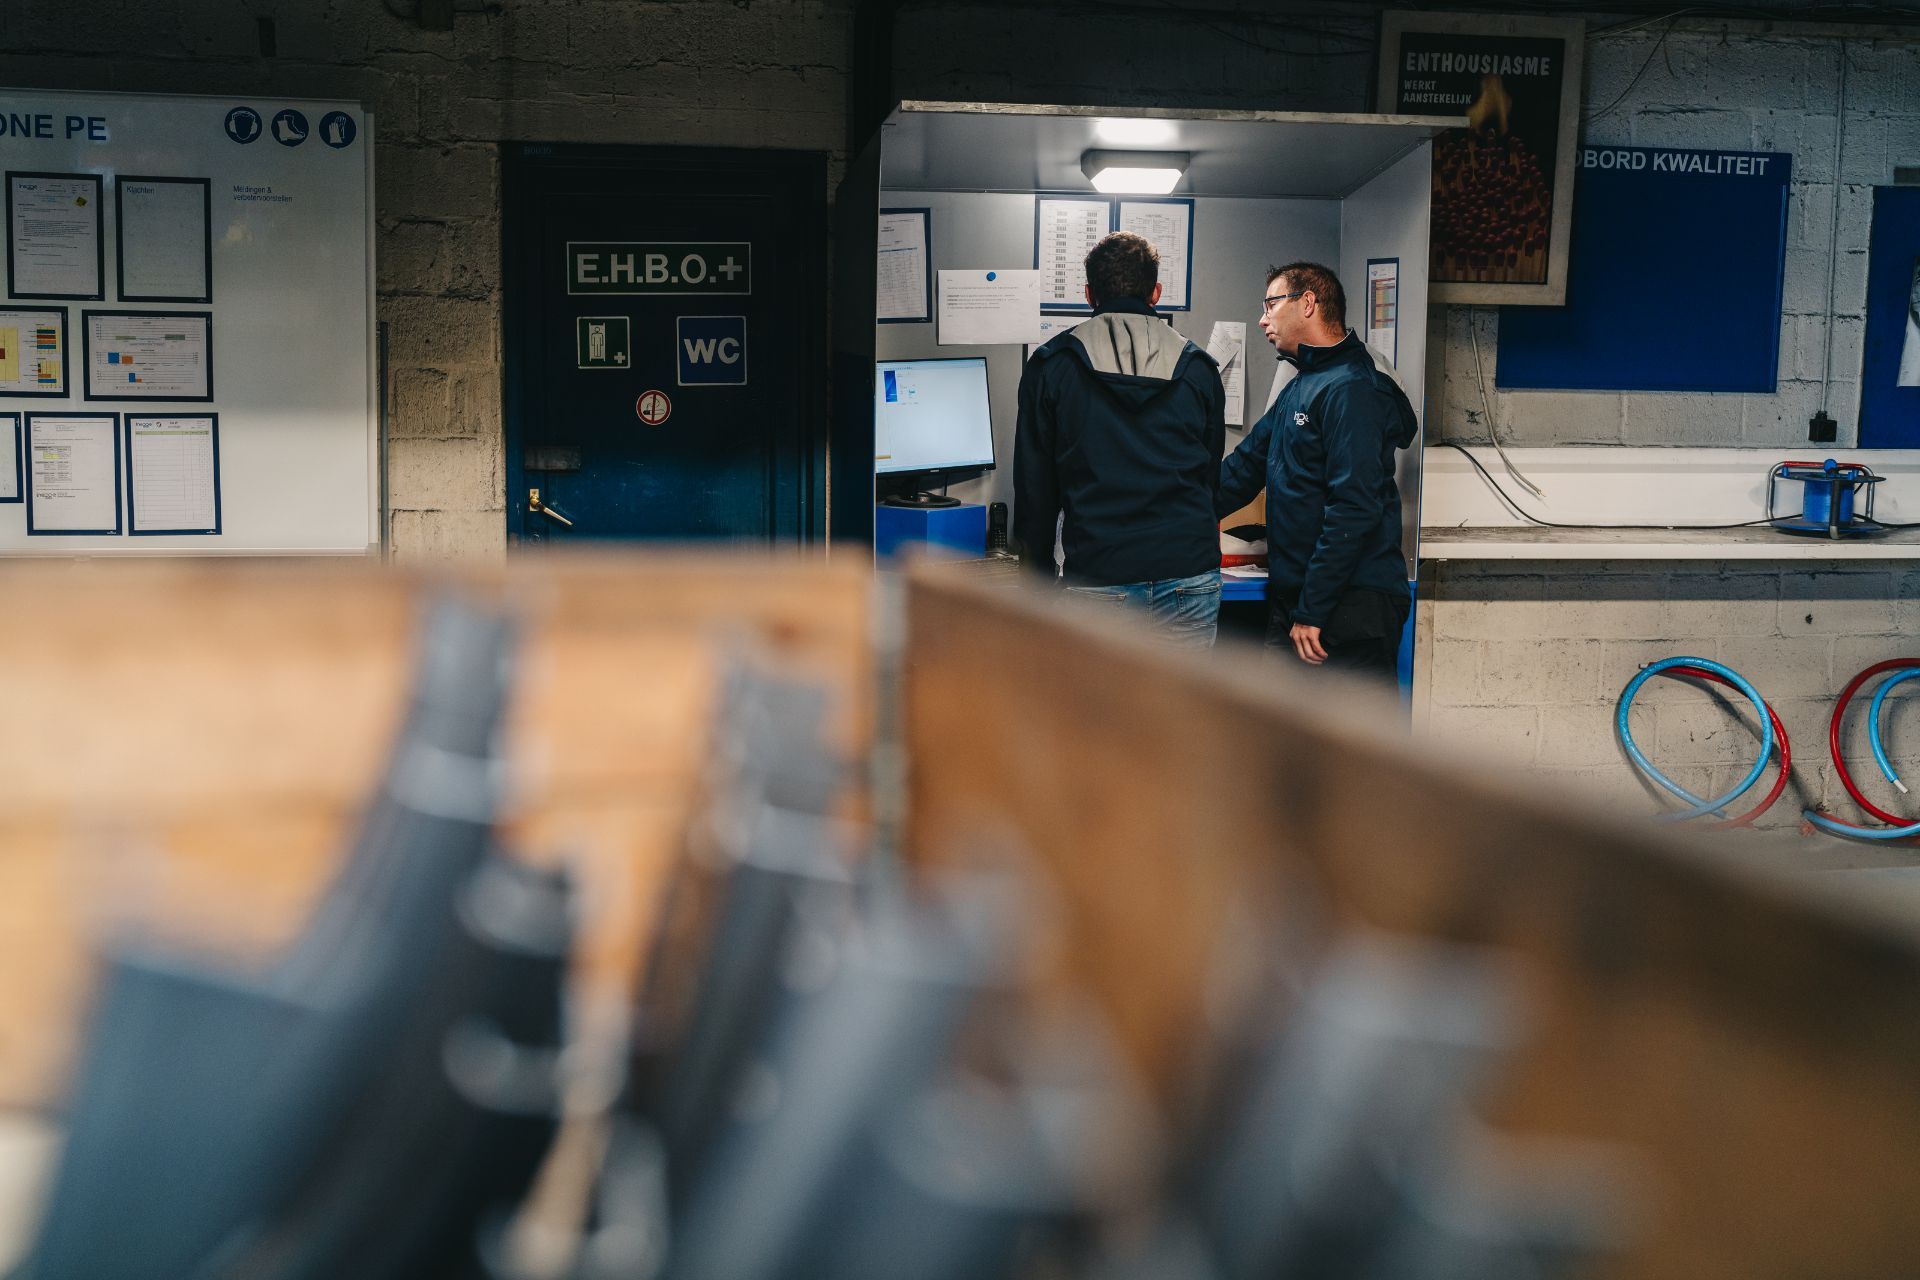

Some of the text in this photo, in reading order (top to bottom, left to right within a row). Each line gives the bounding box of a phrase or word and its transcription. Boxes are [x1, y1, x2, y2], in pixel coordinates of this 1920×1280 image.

[1406, 52, 1551, 76] ENTHOUSIASME
[1404, 80, 1436, 91] WERKT
[1403, 93, 1472, 105] AANSTEKELIJK
[66, 115, 107, 141] PE
[1653, 152, 1769, 176] KWALITEIT
[683, 337, 740, 365] WC
